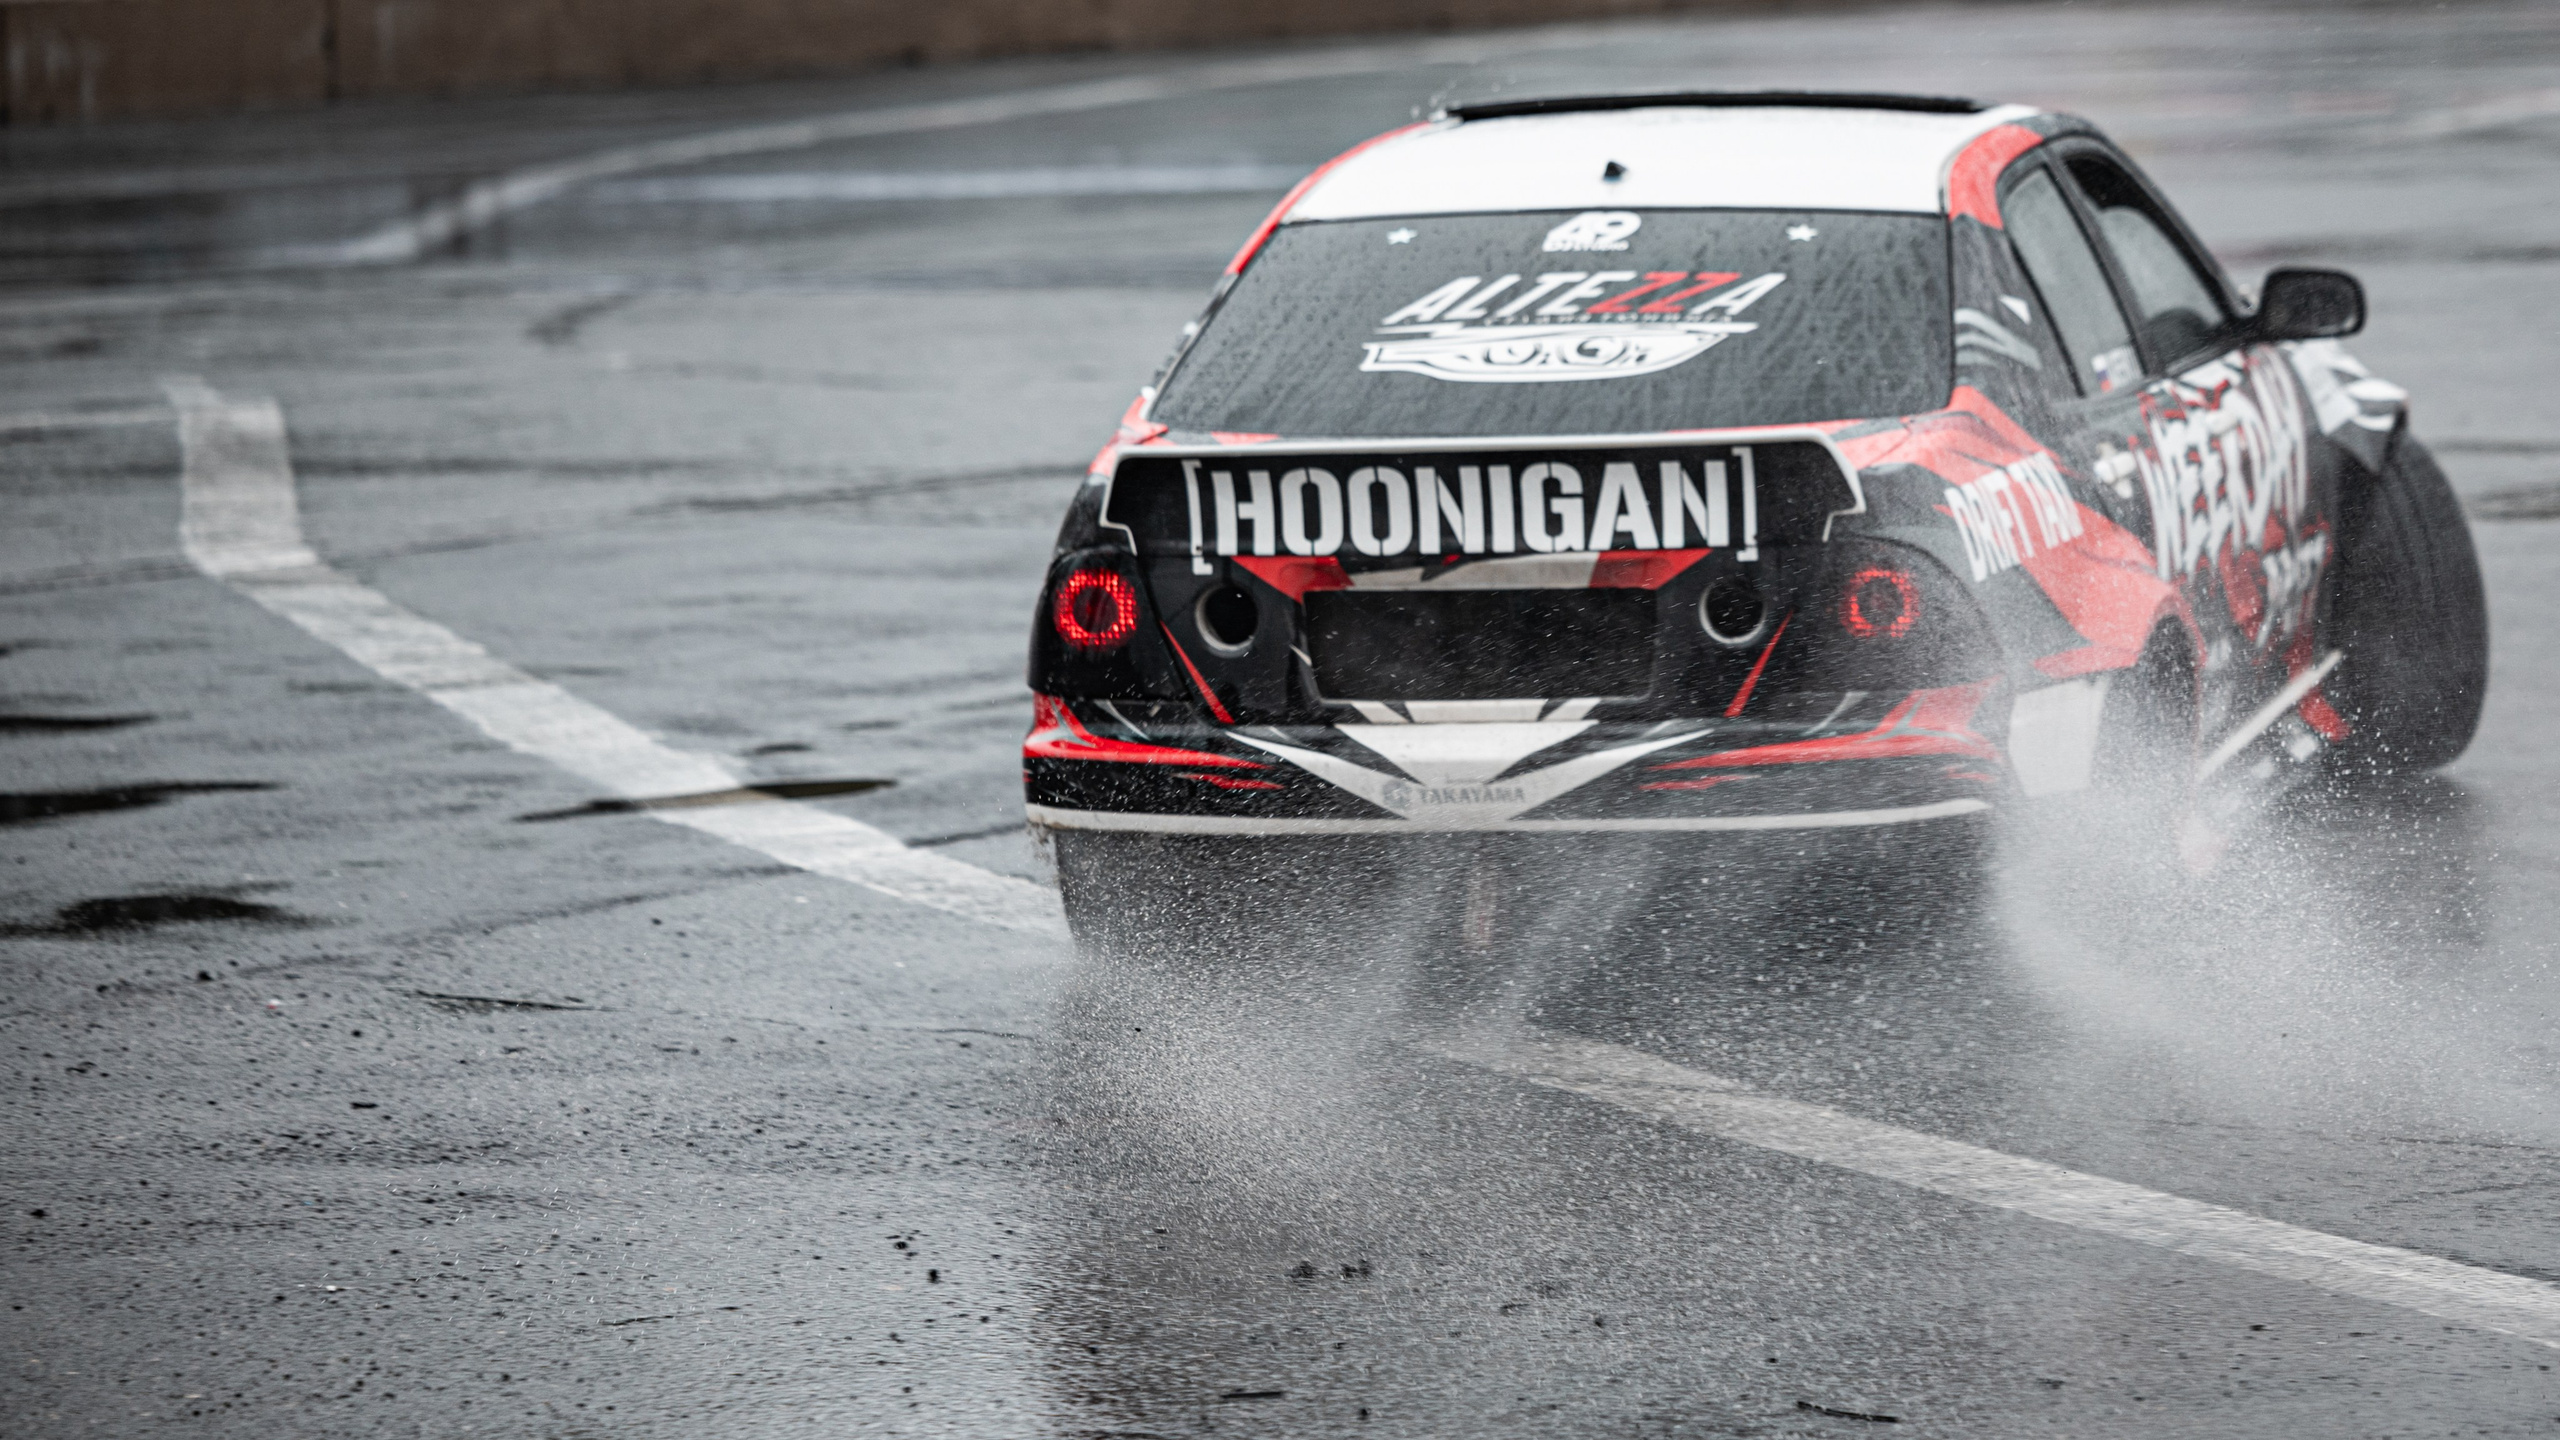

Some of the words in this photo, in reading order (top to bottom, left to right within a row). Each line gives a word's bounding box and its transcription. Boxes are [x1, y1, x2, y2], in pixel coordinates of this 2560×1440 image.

[1382, 271, 1786, 324] ALTEZZA
[1944, 468, 2035, 582] DRIFT
[1416, 787, 1526, 804] TAKAYAMA
